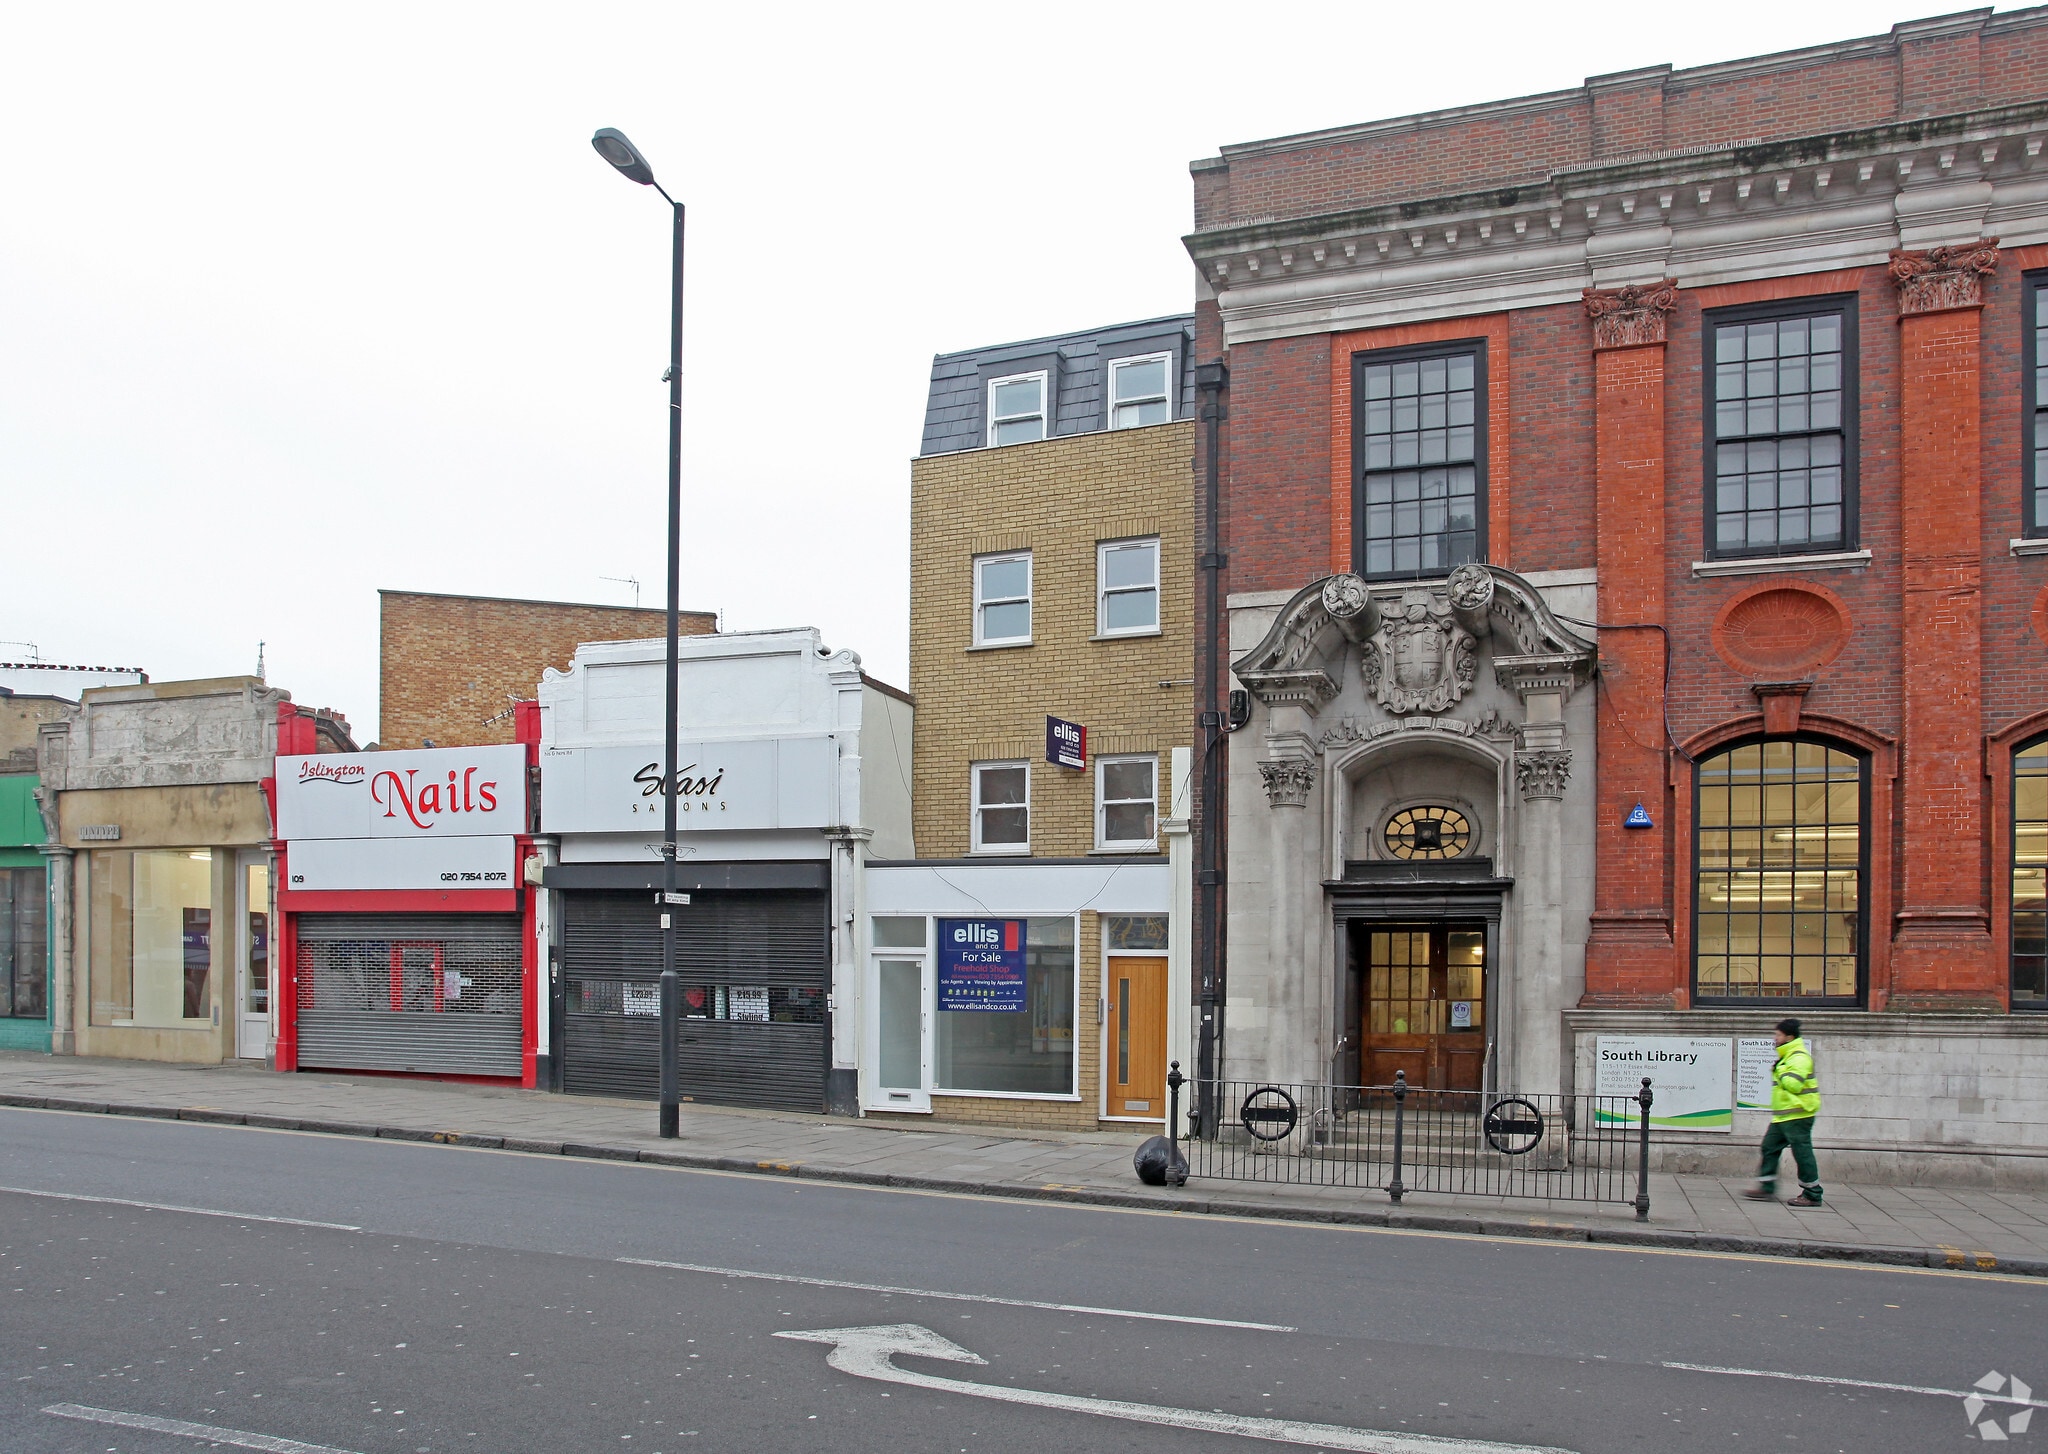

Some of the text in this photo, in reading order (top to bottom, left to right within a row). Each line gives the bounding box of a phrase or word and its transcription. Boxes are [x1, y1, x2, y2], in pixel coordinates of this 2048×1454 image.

[1054, 724, 1080, 742] ellis
[298, 761, 365, 781] Islington
[371, 767, 498, 829] Nails
[633, 802, 726, 812] SAONS
[292, 874, 304, 883] 109
[440, 872, 507, 881] 020 7354 2072
[954, 924, 998, 942] ellis
[963, 952, 1001, 962] For Sale
[990, 965, 1010, 973] Shop
[1602, 1050, 1698, 1066] South Library
